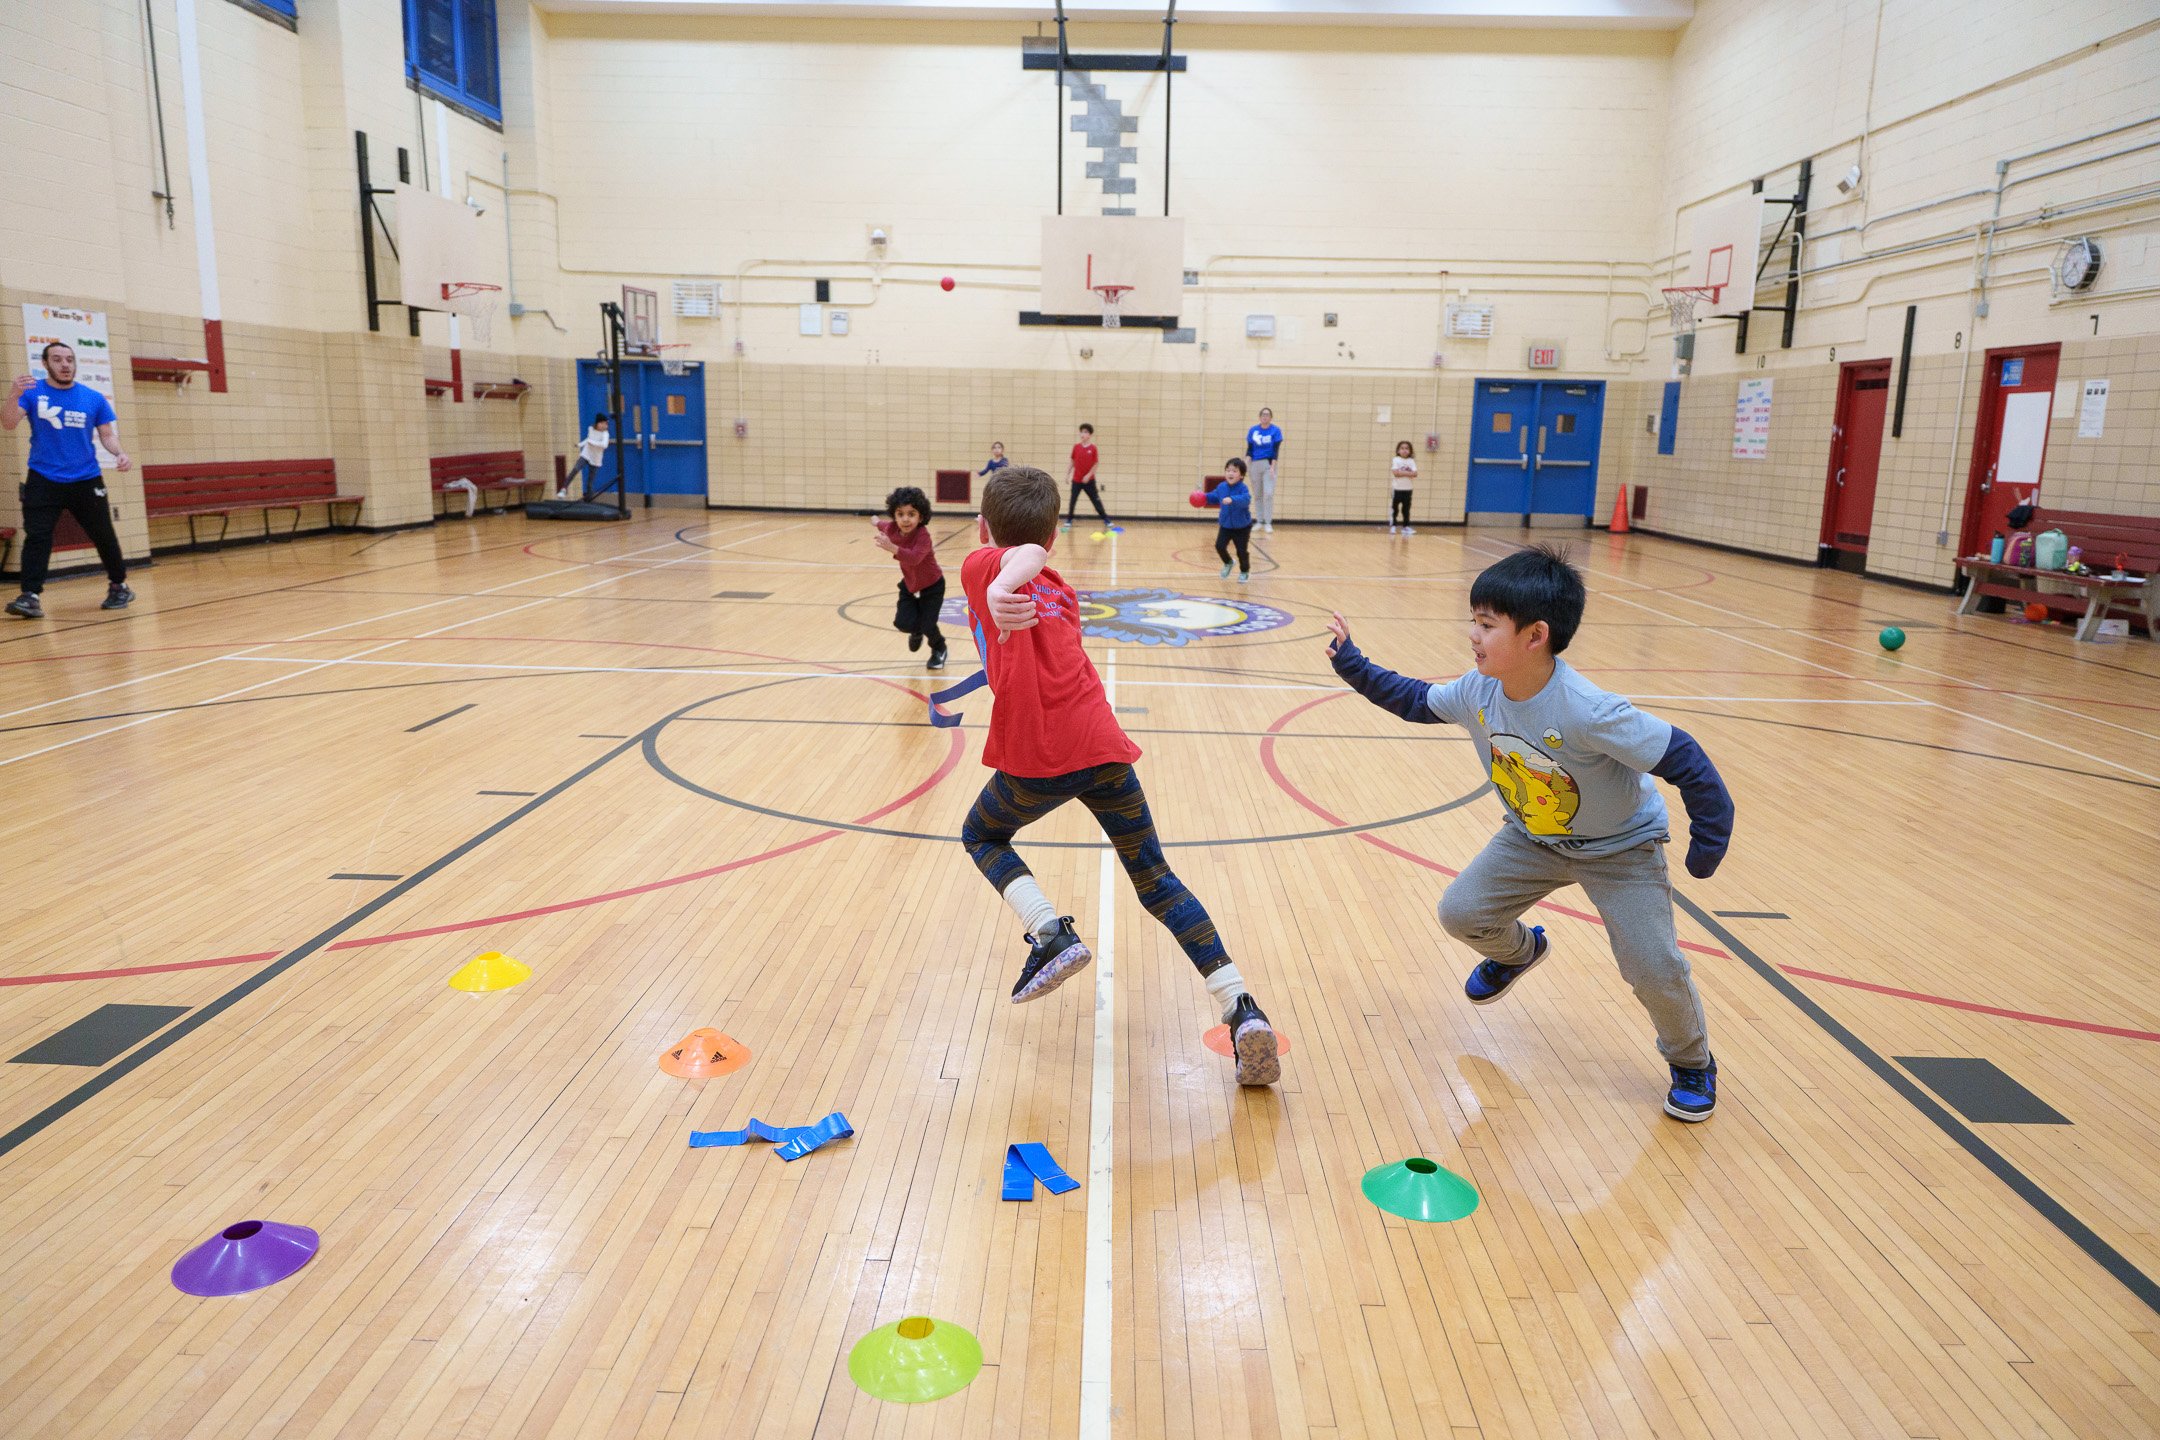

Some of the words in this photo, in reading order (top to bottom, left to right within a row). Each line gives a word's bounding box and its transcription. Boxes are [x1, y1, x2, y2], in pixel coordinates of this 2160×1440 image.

[52, 310, 83, 321] Warm-Ups
[2090, 314, 2099, 335] 7
[1954, 331, 1962, 349] 8
[1534, 349, 1554, 365] EXIT
[1757, 355, 1766, 369] 10
[1830, 347, 1836, 362] 9
